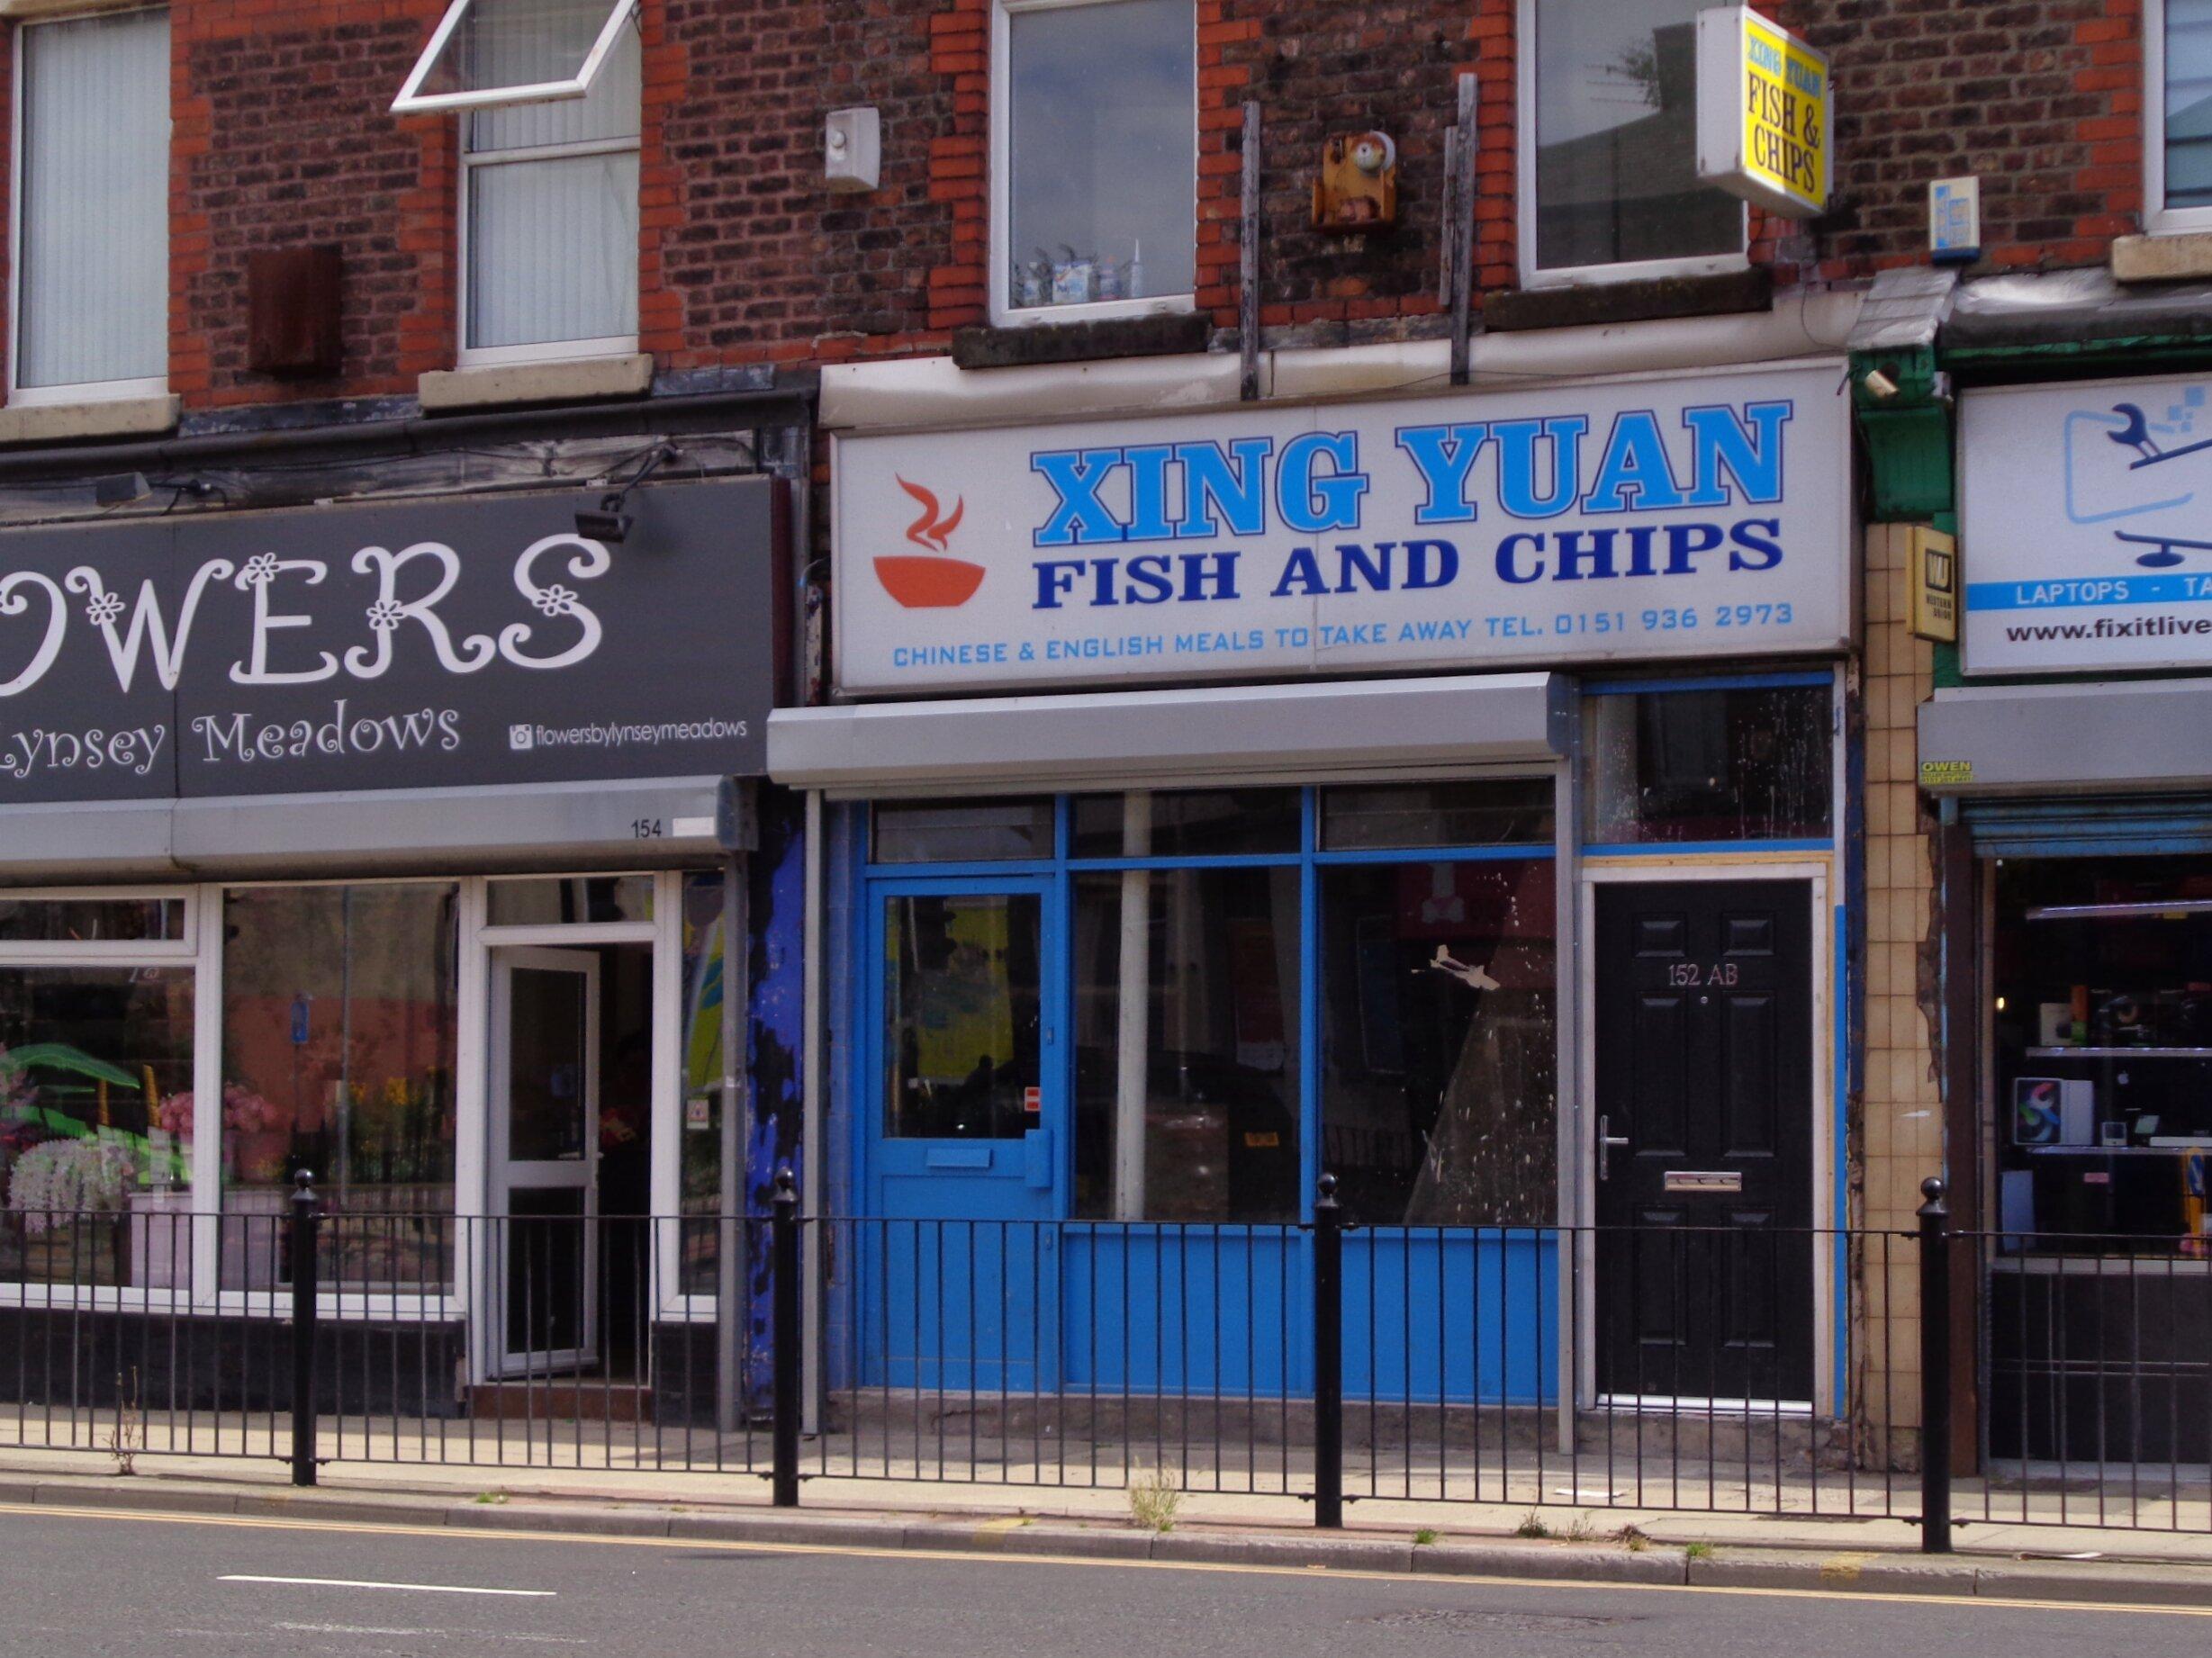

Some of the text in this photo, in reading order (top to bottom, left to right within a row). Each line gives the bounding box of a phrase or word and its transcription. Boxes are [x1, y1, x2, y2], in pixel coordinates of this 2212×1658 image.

[1747, 70, 1820, 150] FISH &
[1755, 124, 1815, 194] CHIPS
[1030, 400, 1793, 547] XING YUAN
[1032, 518, 1784, 608] FISH AND CHIPS
[2017, 581, 2129, 605] LAPTOPS
[894, 602, 1793, 667] CHINESE & ENGLISH MEALS TO TAKE AWAY TEL. 0151 936 2973
[2007, 615, 2212, 642] www.fixitlive
[192, 699, 461, 762] Meadows
[536, 717, 747, 746] flowersbylynseymeadows
[1922, 761, 1972, 772] OWEN
[631, 818, 663, 838] 154
[1668, 963, 1738, 987] 152 AB
